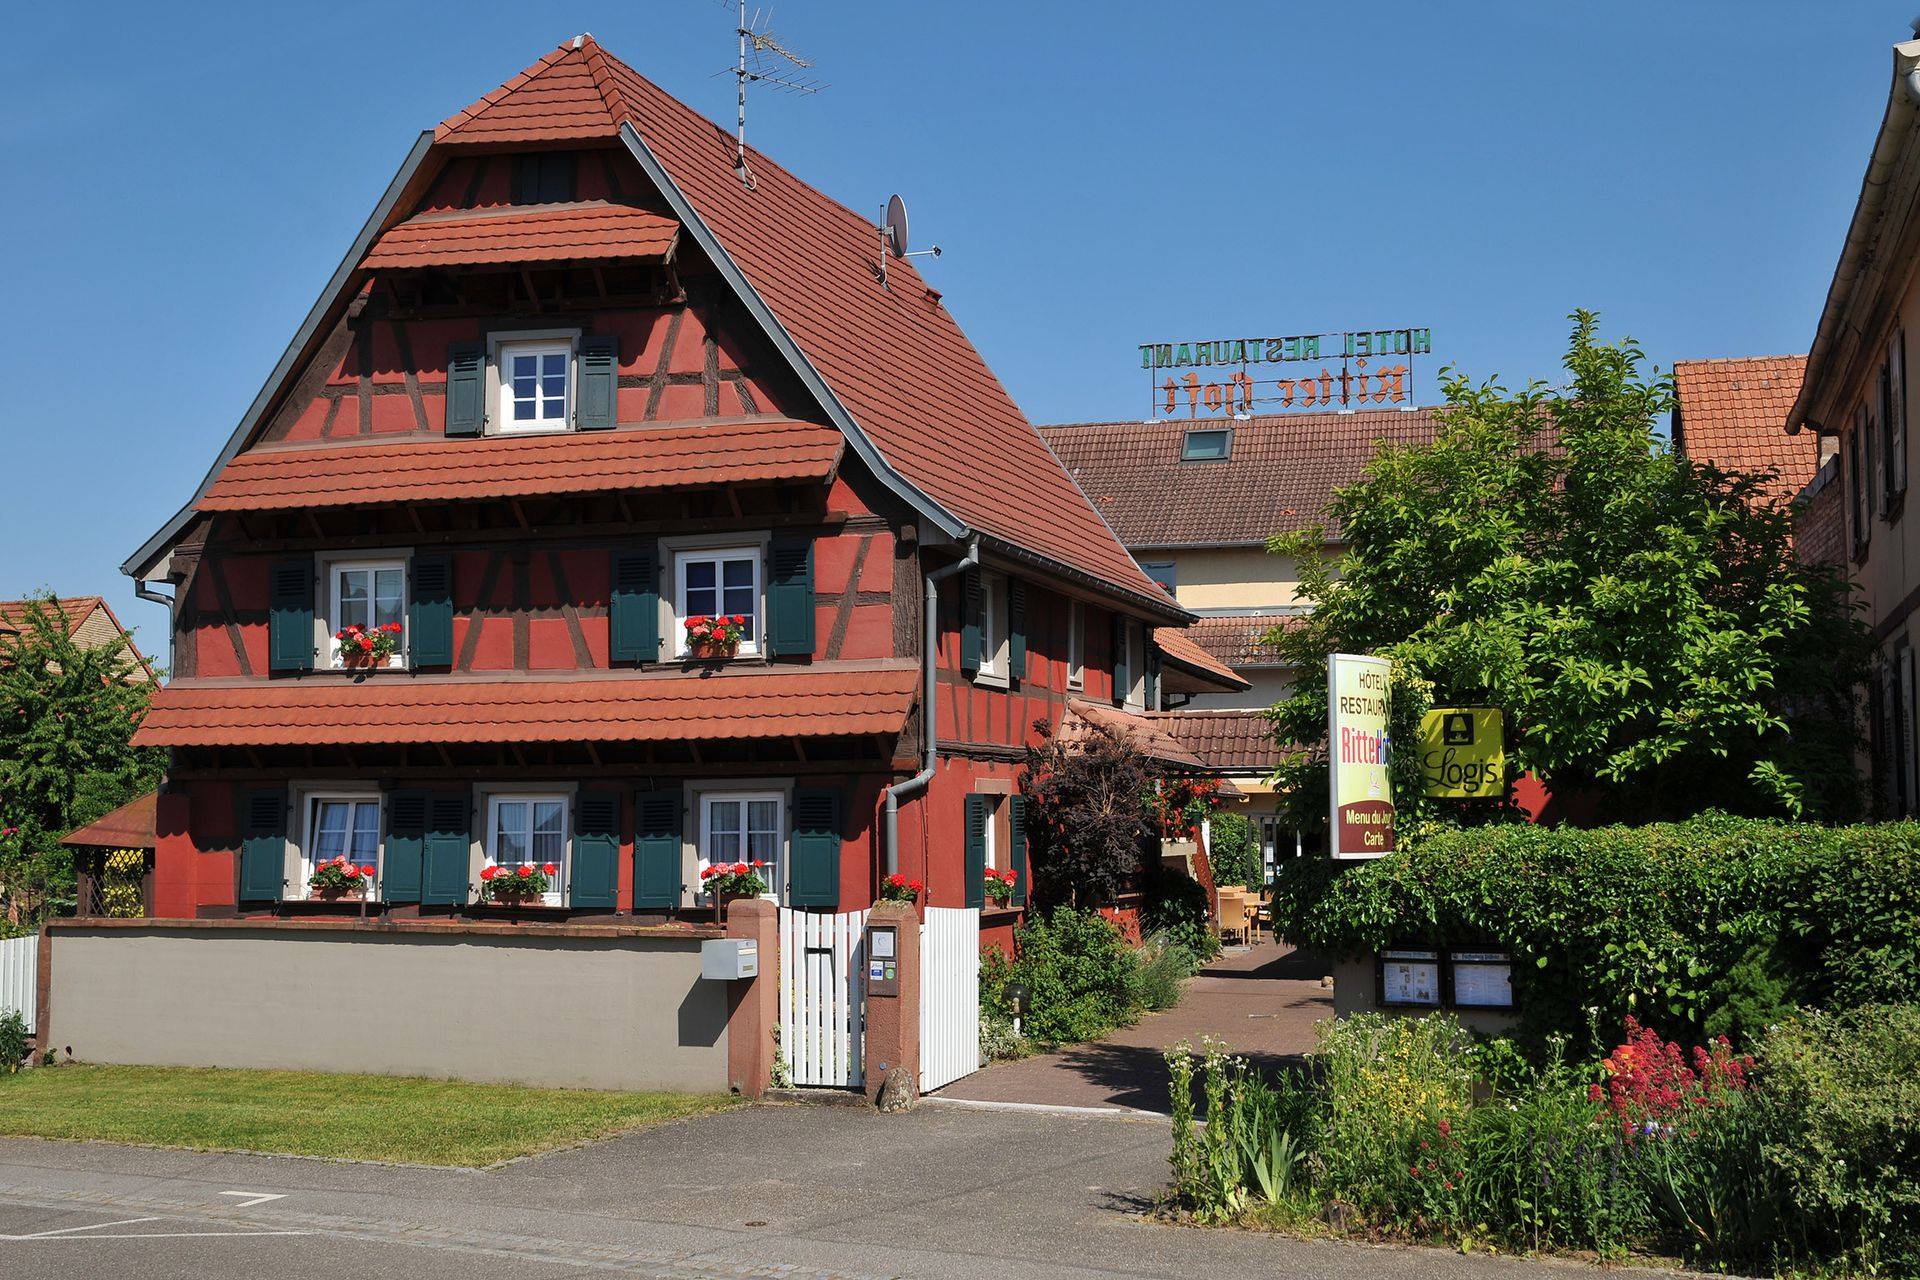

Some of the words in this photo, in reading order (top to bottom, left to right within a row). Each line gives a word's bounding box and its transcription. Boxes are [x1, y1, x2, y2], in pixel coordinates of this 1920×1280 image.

[1358, 669, 1384, 691] HÔTEL
[1423, 747, 1498, 793] Logis
[1345, 808, 1371, 825] Menu
[1372, 809, 1381, 825] du
[1363, 830, 1385, 847] Carte
